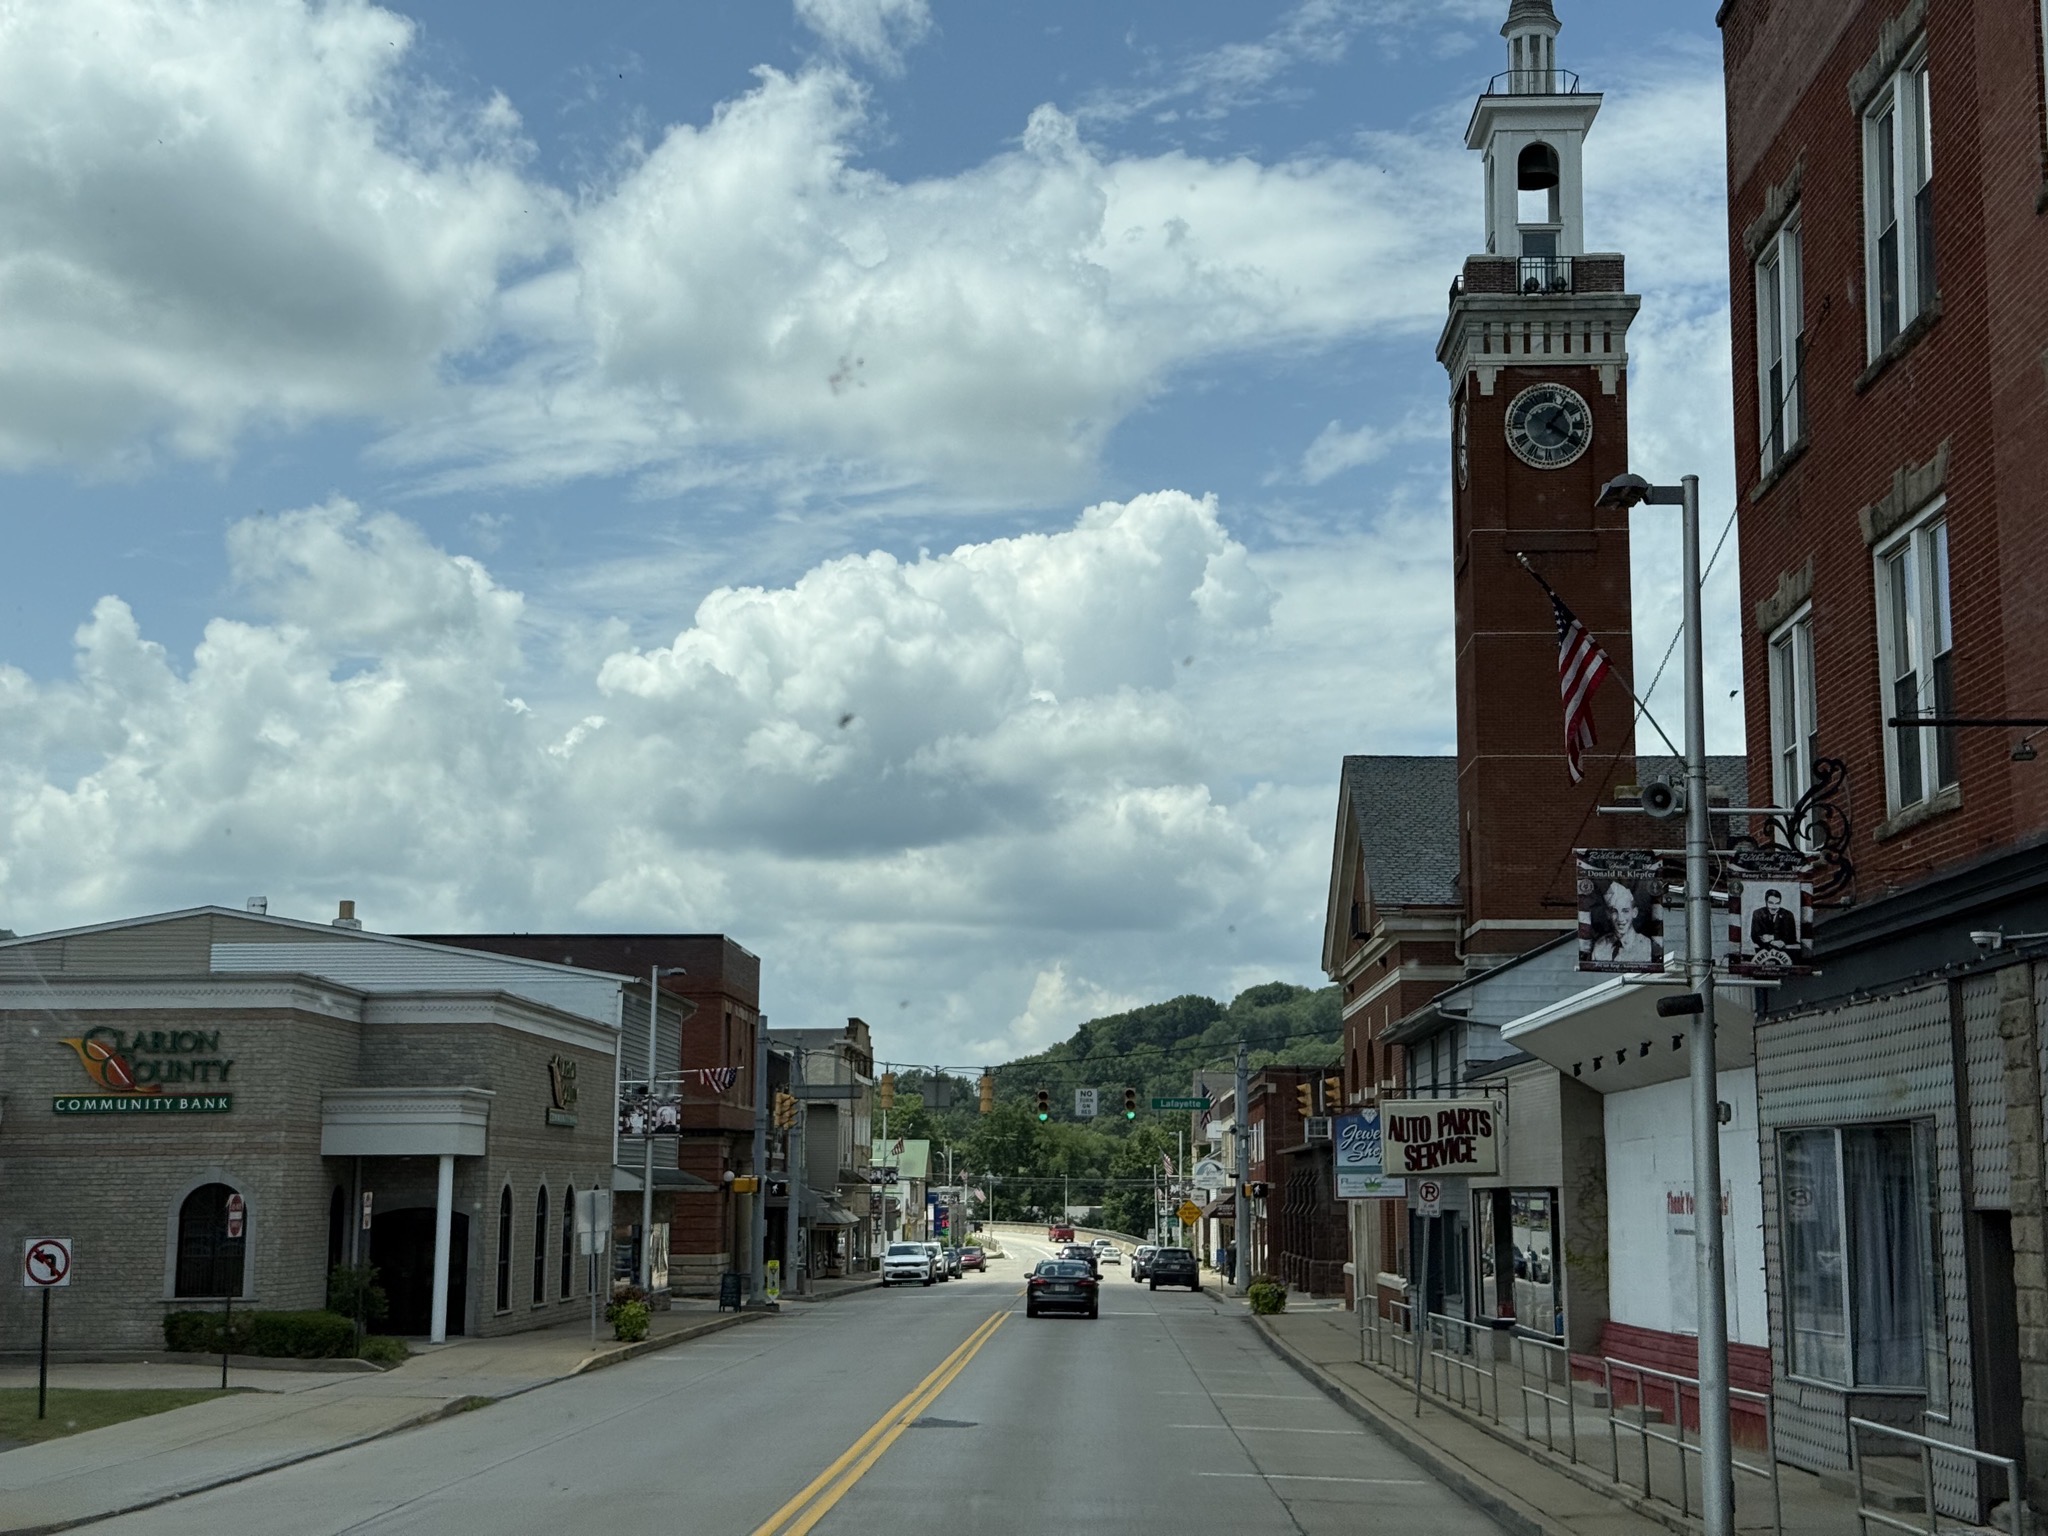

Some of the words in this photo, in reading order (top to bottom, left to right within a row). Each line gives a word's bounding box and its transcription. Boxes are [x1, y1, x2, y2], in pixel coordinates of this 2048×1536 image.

[1587, 870, 1616, 878] Donald
[1627, 870, 1656, 880] Klepfer
[81, 1026, 220, 1062] CLARION
[101, 1053, 234, 1090] COUNTY
[55, 1098, 174, 1111] COMMUNITY
[180, 1097, 229, 1110] BANK
[1160, 1099, 1202, 1110] Lafayette
[1341, 1124, 1382, 1150] Jewe
[1388, 1115, 1432, 1143] AUTO
[1437, 1108, 1492, 1138] PARTS
[1404, 1136, 1478, 1172] SERVICE
[1667, 1190, 1685, 1215] Thank
[1685, 1191, 1696, 1215] Yo
